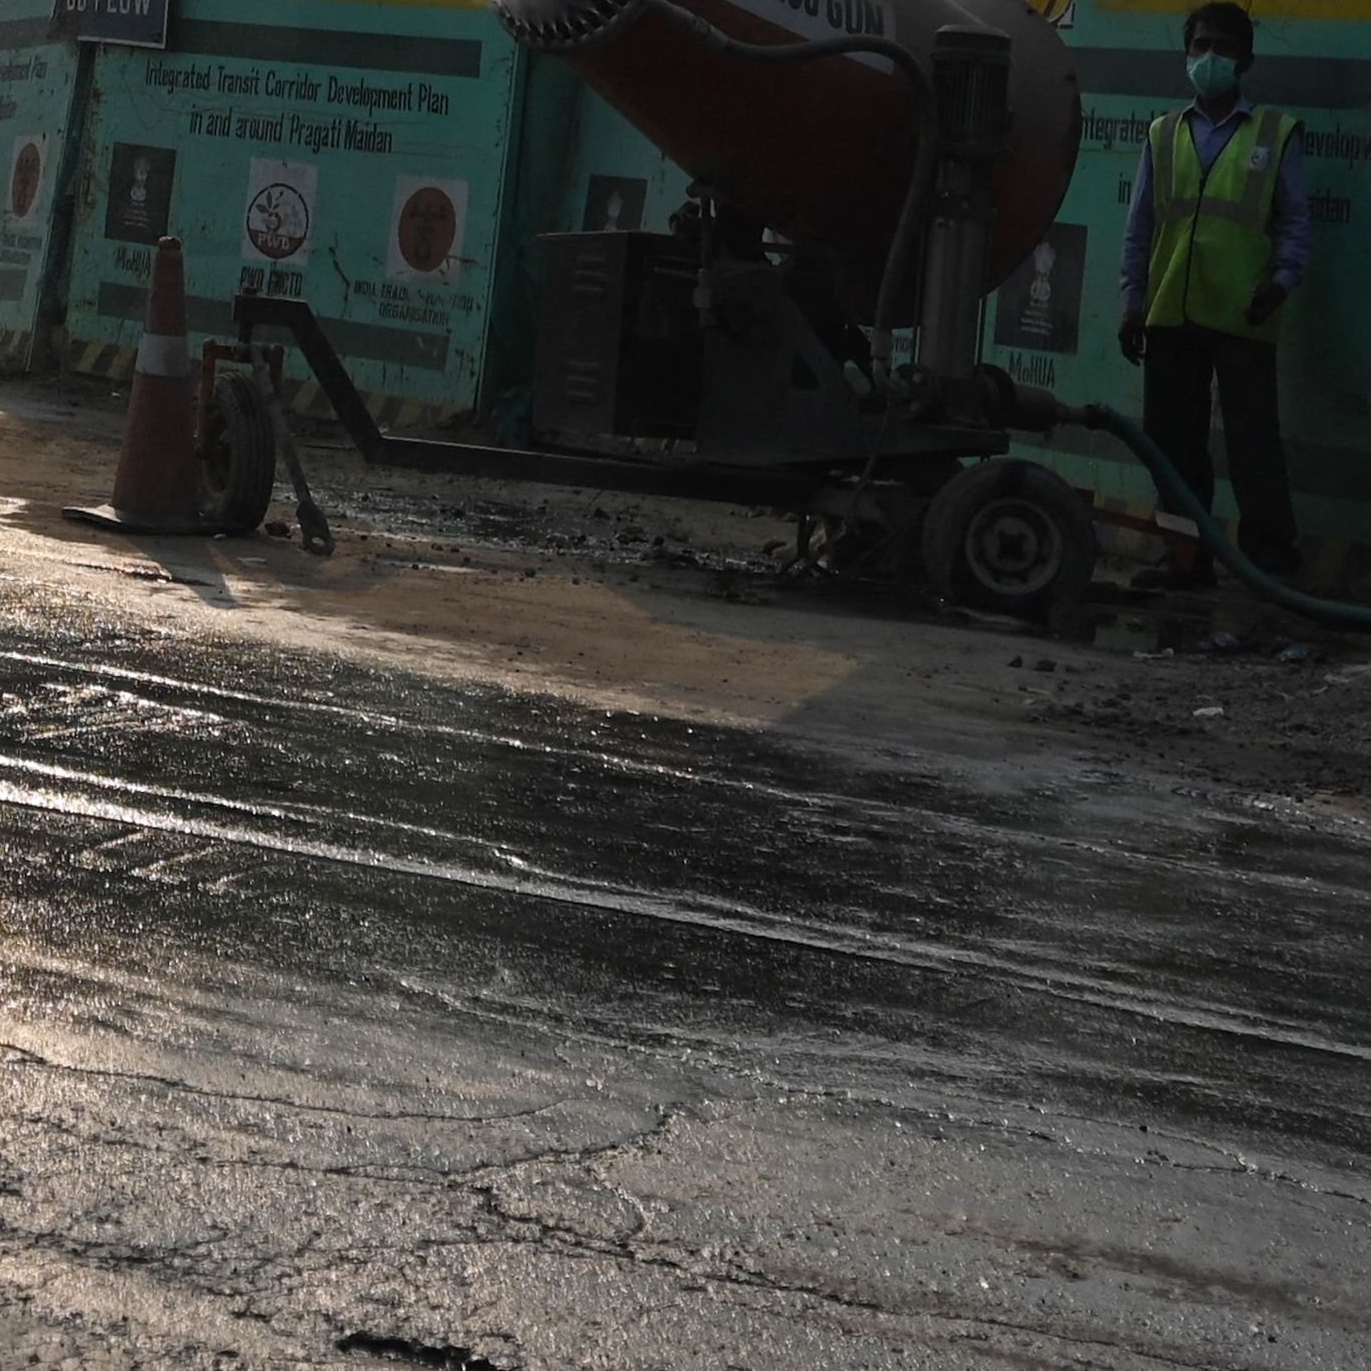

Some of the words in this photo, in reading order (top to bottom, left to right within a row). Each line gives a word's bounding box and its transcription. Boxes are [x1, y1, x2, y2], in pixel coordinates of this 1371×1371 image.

[144, 58, 211, 94] Integrated
[217, 65, 261, 94] Transit
[264, 70, 323, 103] Corridor
[326, 75, 414, 118] Development
[417, 84, 450, 116] Plan
[188, 104, 203, 135] in
[206, 106, 232, 139] and
[235, 112, 284, 143] around
[288, 114, 342, 154] Pragati
[343, 118, 394, 154] Maidan
[1118, 171, 1132, 205] in
[257, 232, 290, 250] PWD
[240, 265, 265, 291] PWD
[1008, 351, 1055, 389] MoHUA
